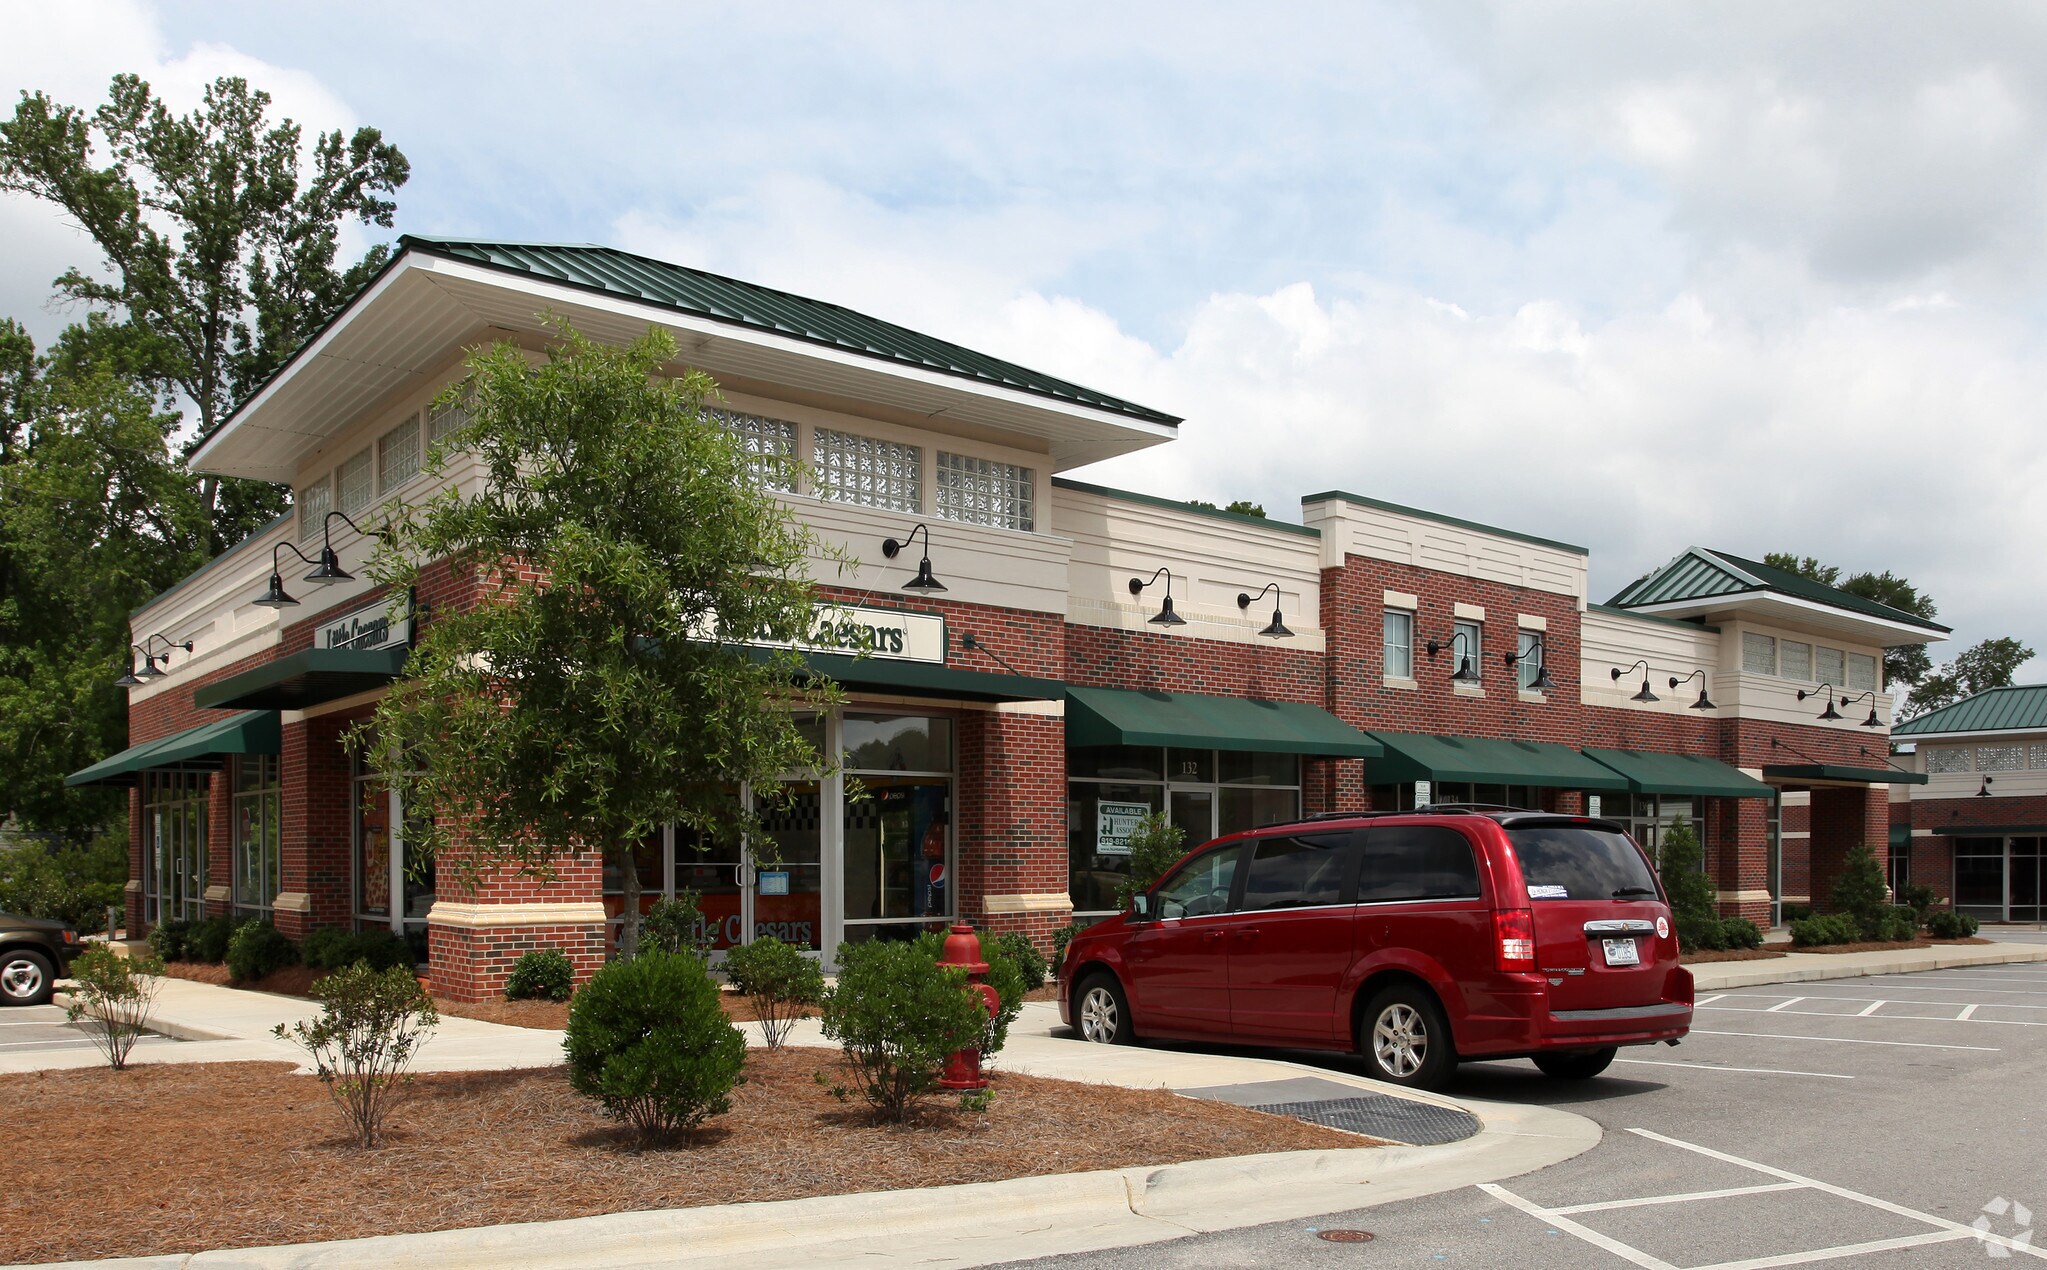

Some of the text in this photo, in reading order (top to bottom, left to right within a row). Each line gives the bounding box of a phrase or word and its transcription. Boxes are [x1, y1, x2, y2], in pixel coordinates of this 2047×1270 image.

[795, 604, 904, 653] aesars
[1182, 762, 1197, 774] 132
[1106, 807, 1142, 815] AVAILABLE
[725, 914, 812, 944] Cesars
